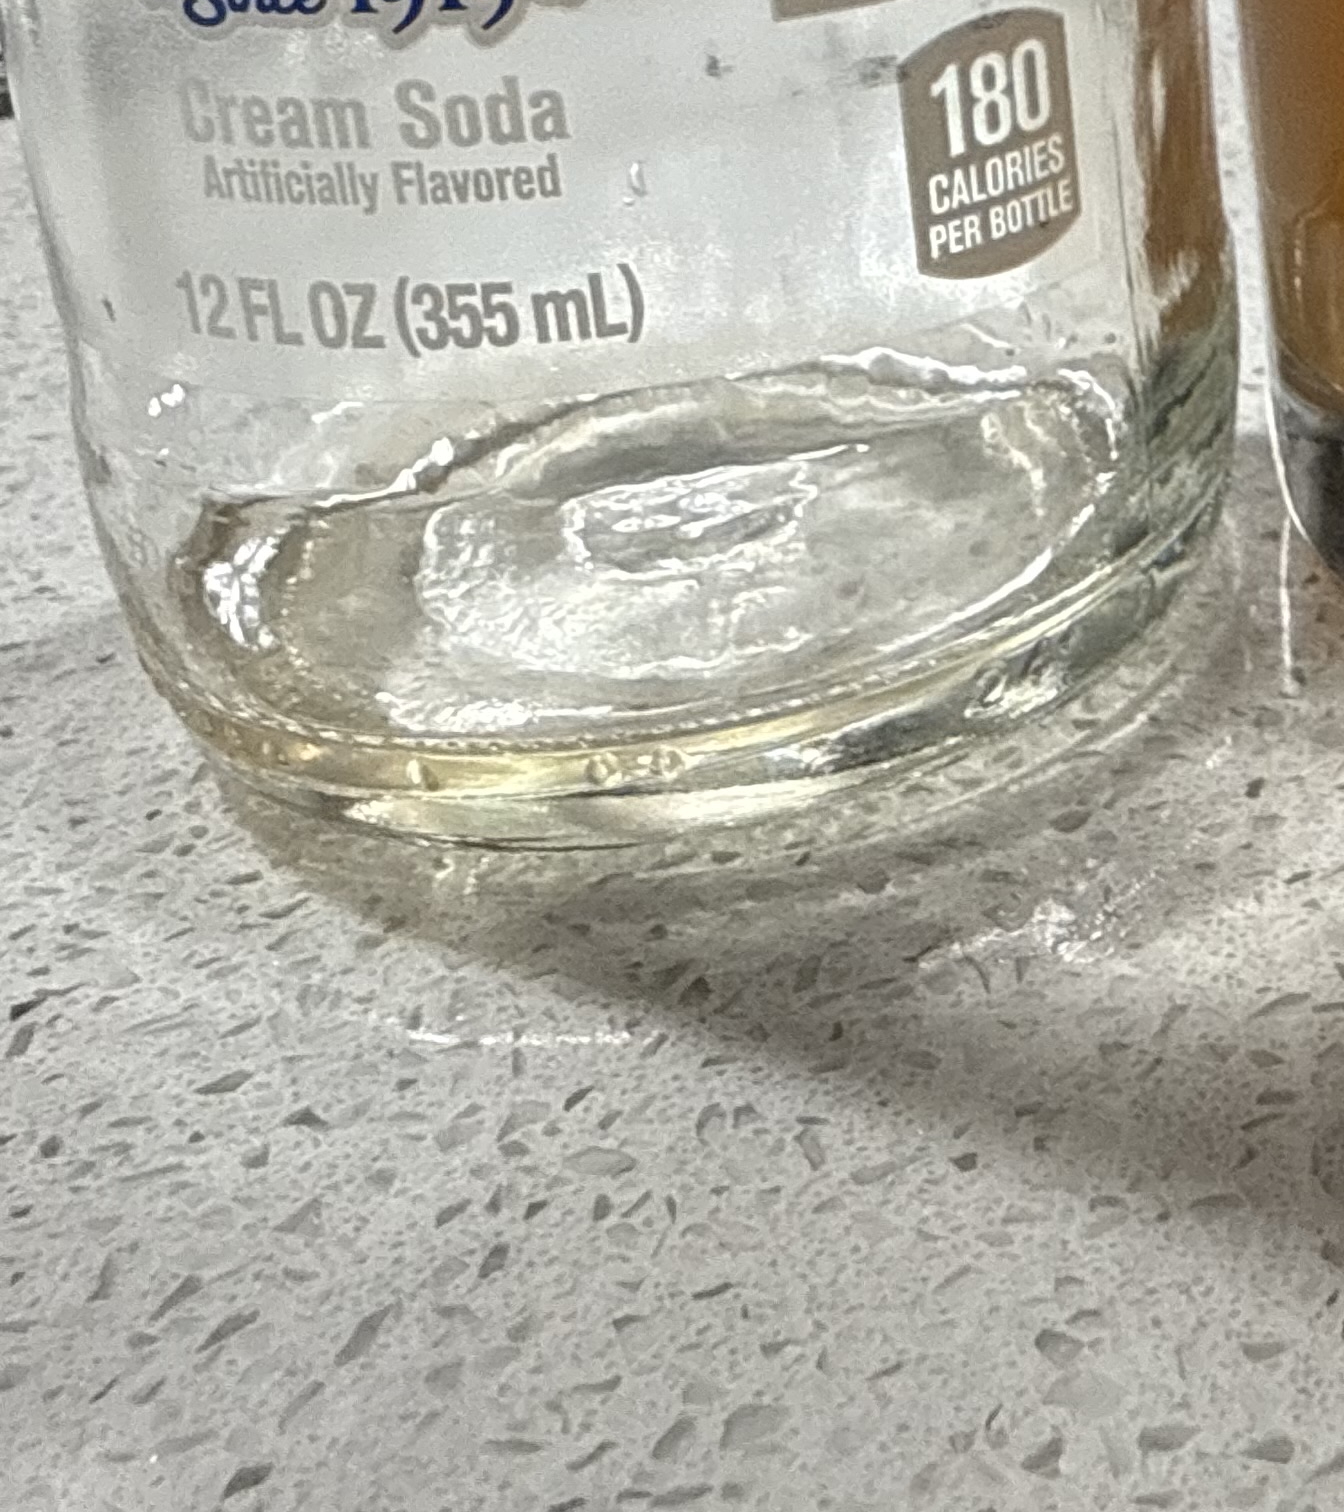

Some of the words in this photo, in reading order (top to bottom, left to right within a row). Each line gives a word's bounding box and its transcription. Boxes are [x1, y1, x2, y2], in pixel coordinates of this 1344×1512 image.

[179, 78, 371, 149] Cream
[396, 76, 572, 149] Soda
[930, 39, 1049, 158] 180
[203, 156, 378, 215] Artificially
[392, 153, 563, 206] Flavored
[928, 133, 1066, 215] CALORIES
[929, 215, 983, 259] PER
[989, 178, 1074, 240] BOTTLE
[176, 270, 237, 339] 12
[238, 276, 303, 346] FL
[308, 281, 387, 350] OZ
[394, 274, 519, 358] (355
[531, 264, 645, 344] mL)
